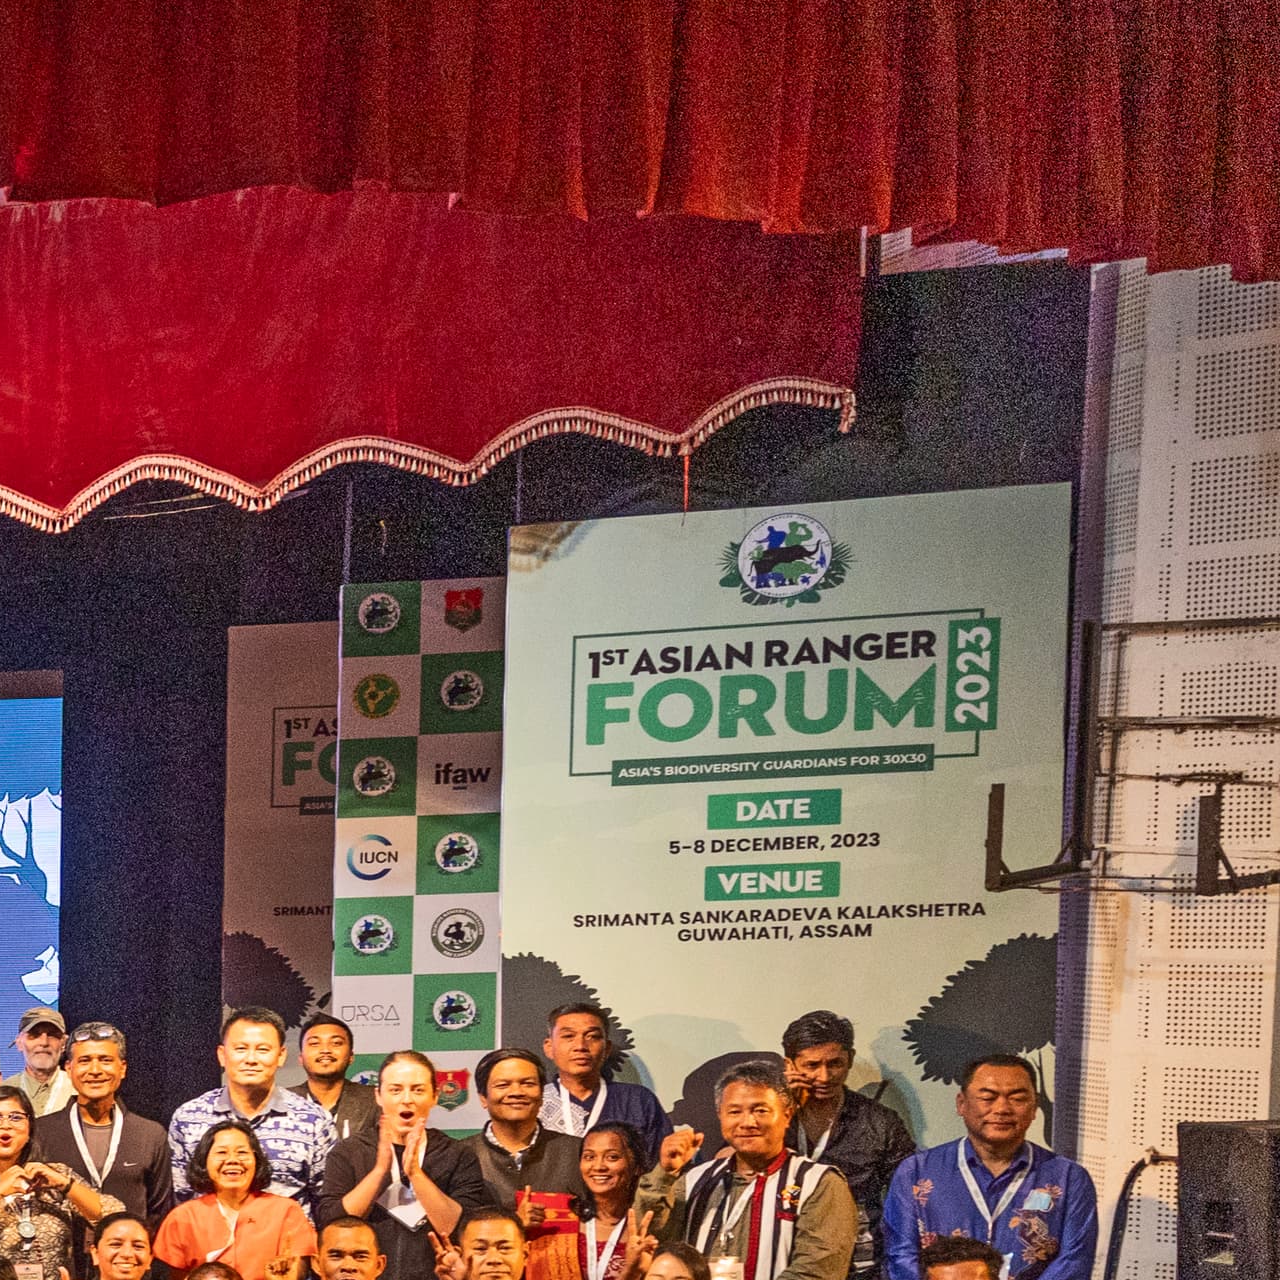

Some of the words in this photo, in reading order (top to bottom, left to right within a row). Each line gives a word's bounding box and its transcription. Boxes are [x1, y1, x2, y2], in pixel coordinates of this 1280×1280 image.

[589, 649, 628, 678] 1ST
[630, 642, 754, 676] ASIAN
[765, 630, 936, 668] RANGER
[953, 626, 992, 725] 2023
[585, 663, 936, 746] FORUM
[284, 718, 311, 738] 1ST
[434, 763, 490, 785] ifaw
[619, 766, 661, 779] ASIA'S
[664, 761, 760, 776] BIODIVERSITY
[763, 757, 847, 771] GUARDIANS
[851, 755, 879, 767] FOR
[883, 752, 927, 765] 30X30
[736, 798, 811, 821] DATE
[711, 835, 825, 855] DECEMBER,
[831, 832, 880, 848] 2023
[359, 850, 398, 865] IUCN
[718, 870, 823, 893] VENUE
[273, 905, 332, 916] SRIMANT
[573, 910, 674, 927] SRIMANTA
[680, 906, 831, 924] SANKARADEVA
[837, 902, 986, 921] KALAKSHETRA
[678, 924, 794, 943] GUWAHATI,
[799, 923, 873, 939] ASSAM
[341, 1004, 400, 1022] URSA
